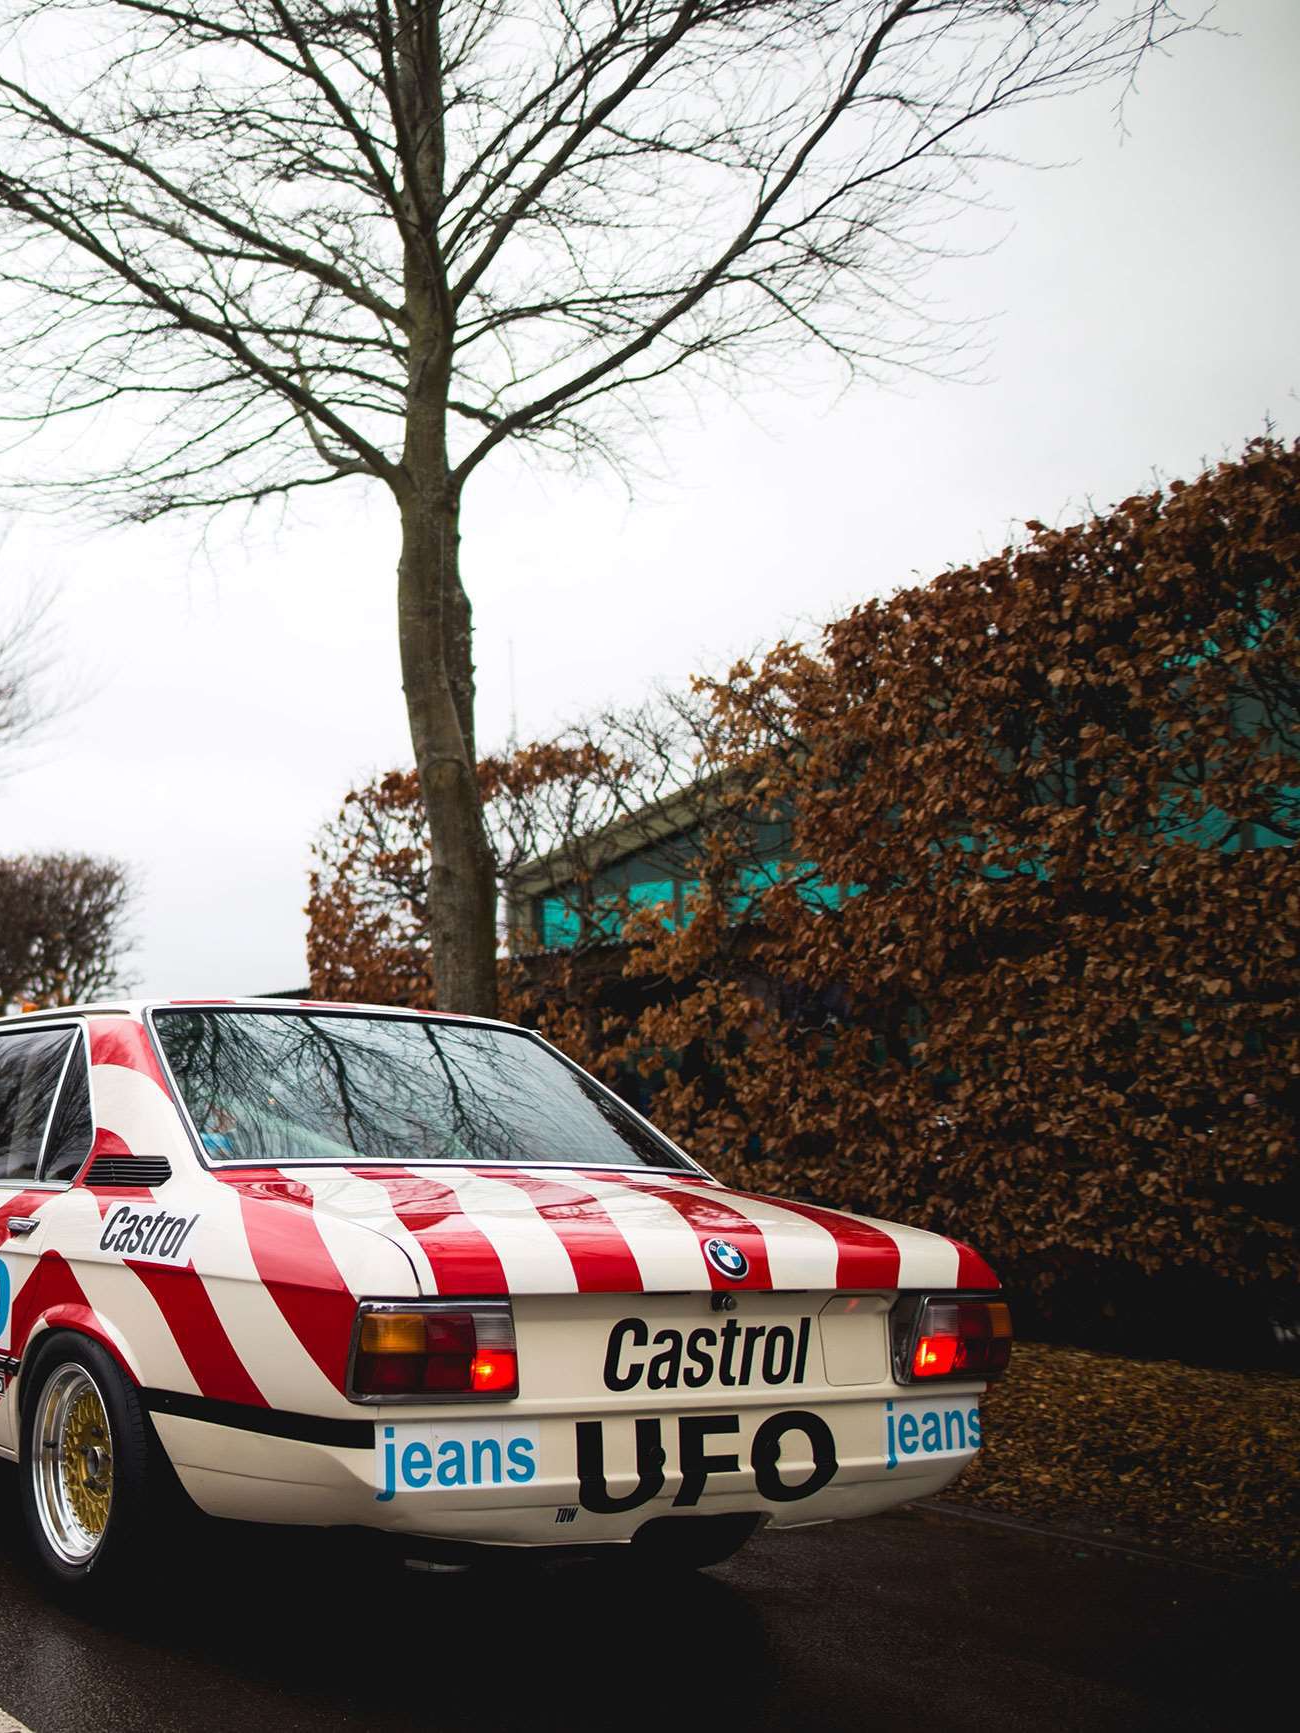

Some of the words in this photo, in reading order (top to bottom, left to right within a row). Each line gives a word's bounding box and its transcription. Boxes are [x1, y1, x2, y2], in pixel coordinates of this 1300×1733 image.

[100, 1206, 200, 1258] Castrol
[603, 1317, 811, 1392] Castrol
[375, 1426, 536, 1502] jeans
[575, 1410, 839, 1514] UFO
[886, 1400, 984, 1470] jeans
[555, 1507, 579, 1523] TOW
